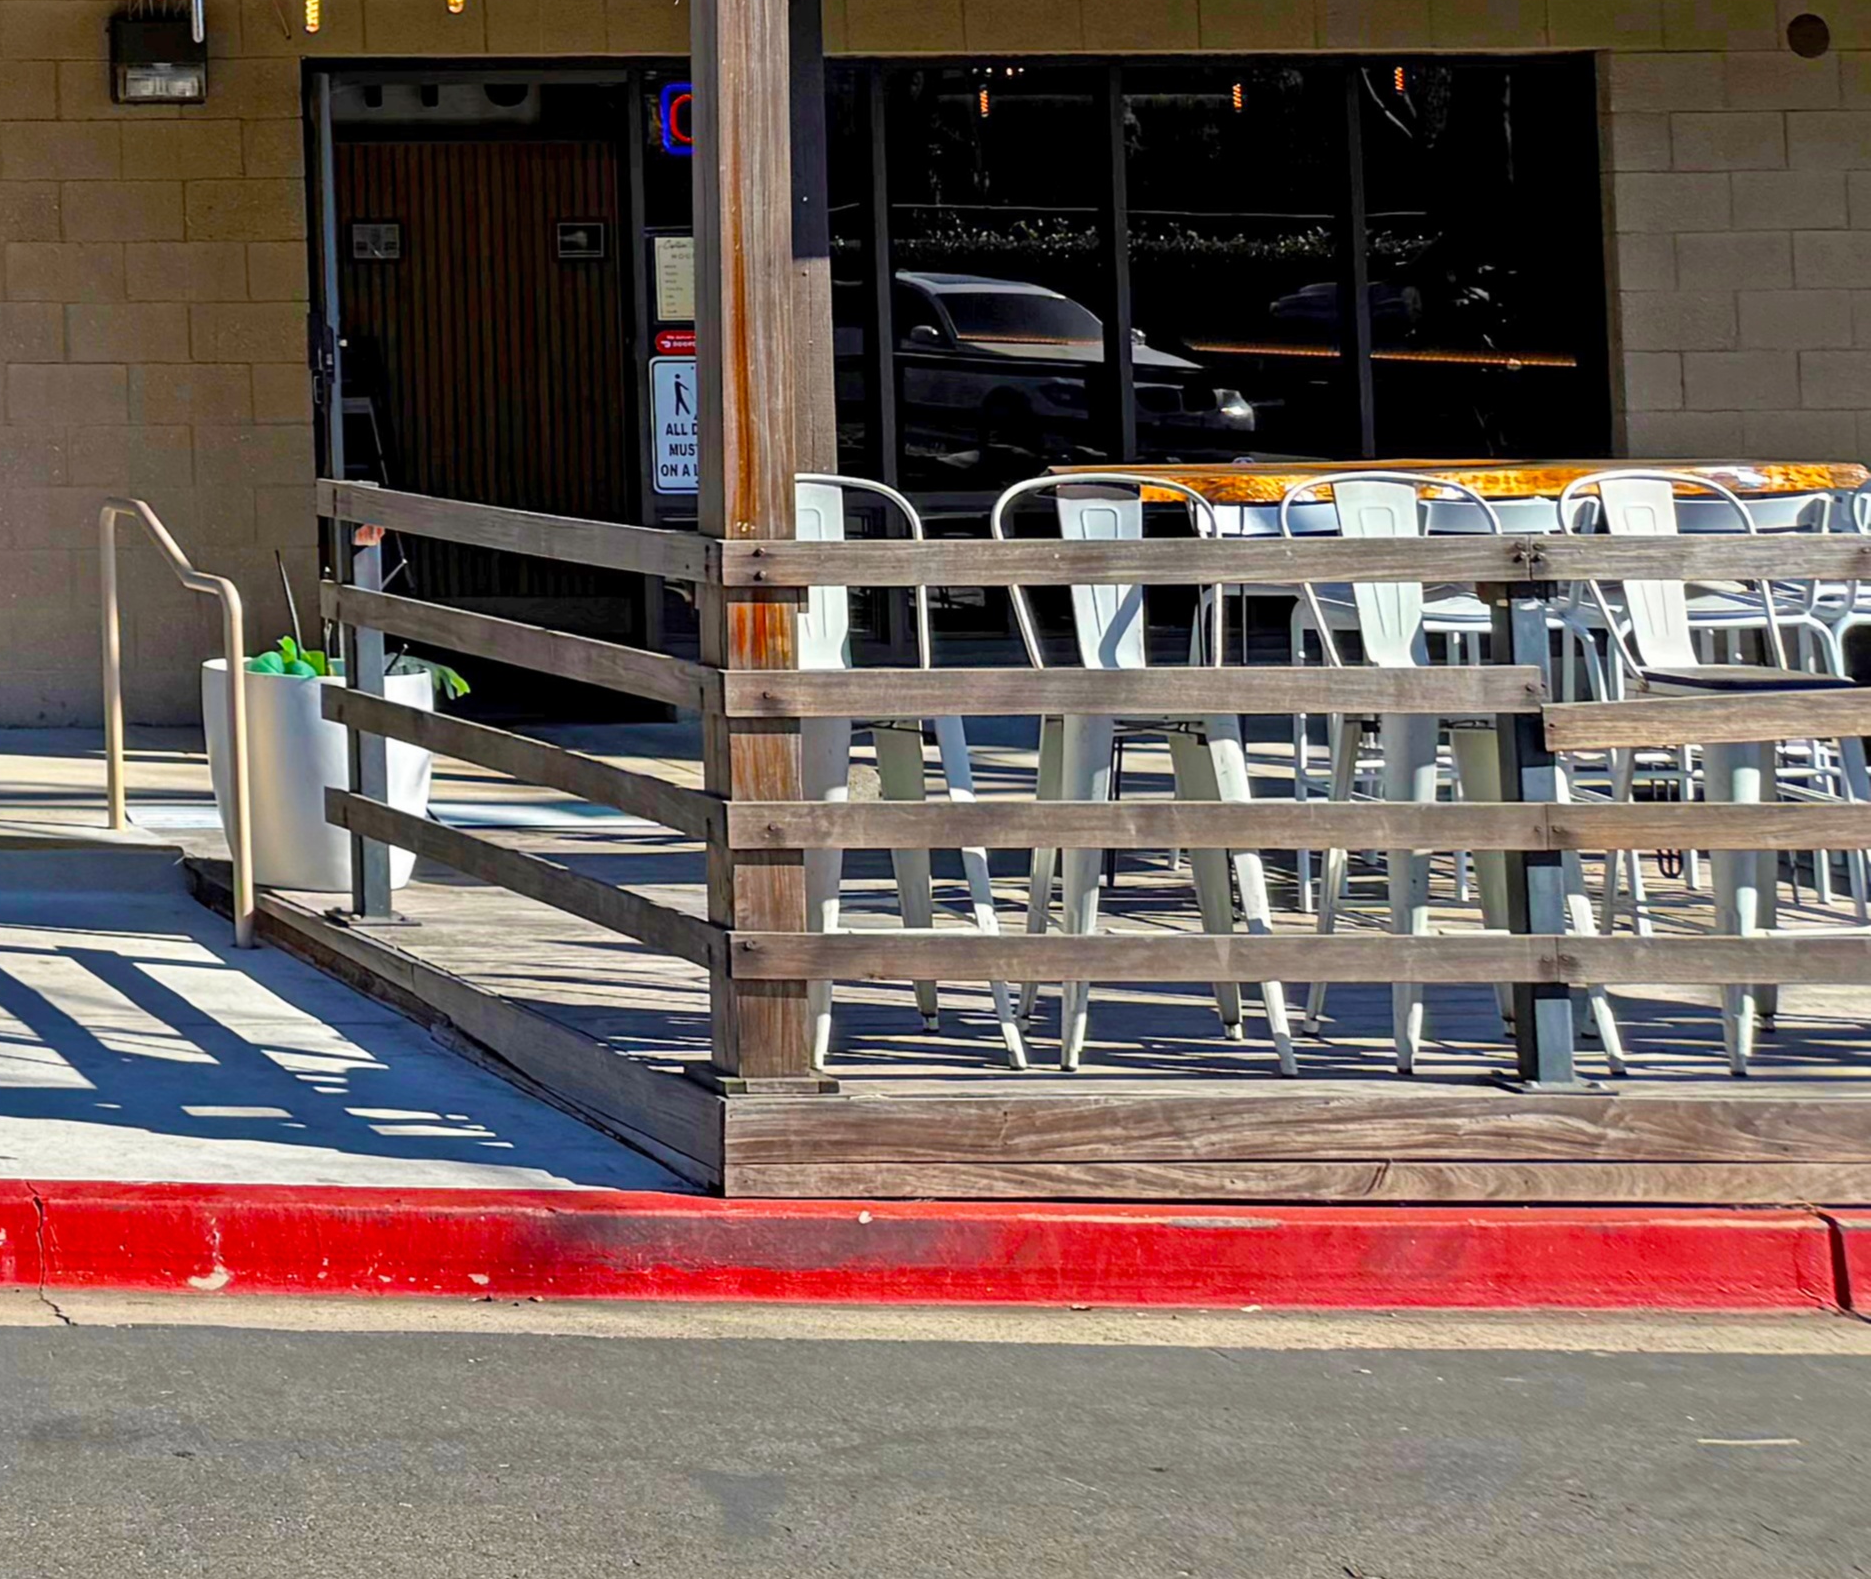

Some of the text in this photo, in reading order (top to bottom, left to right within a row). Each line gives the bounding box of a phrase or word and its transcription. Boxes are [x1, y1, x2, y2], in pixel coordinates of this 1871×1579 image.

[666, 423, 688, 436] ALL
[669, 443, 698, 457] MUS
[660, 463, 678, 477] ON
[682, 463, 691, 477] A
